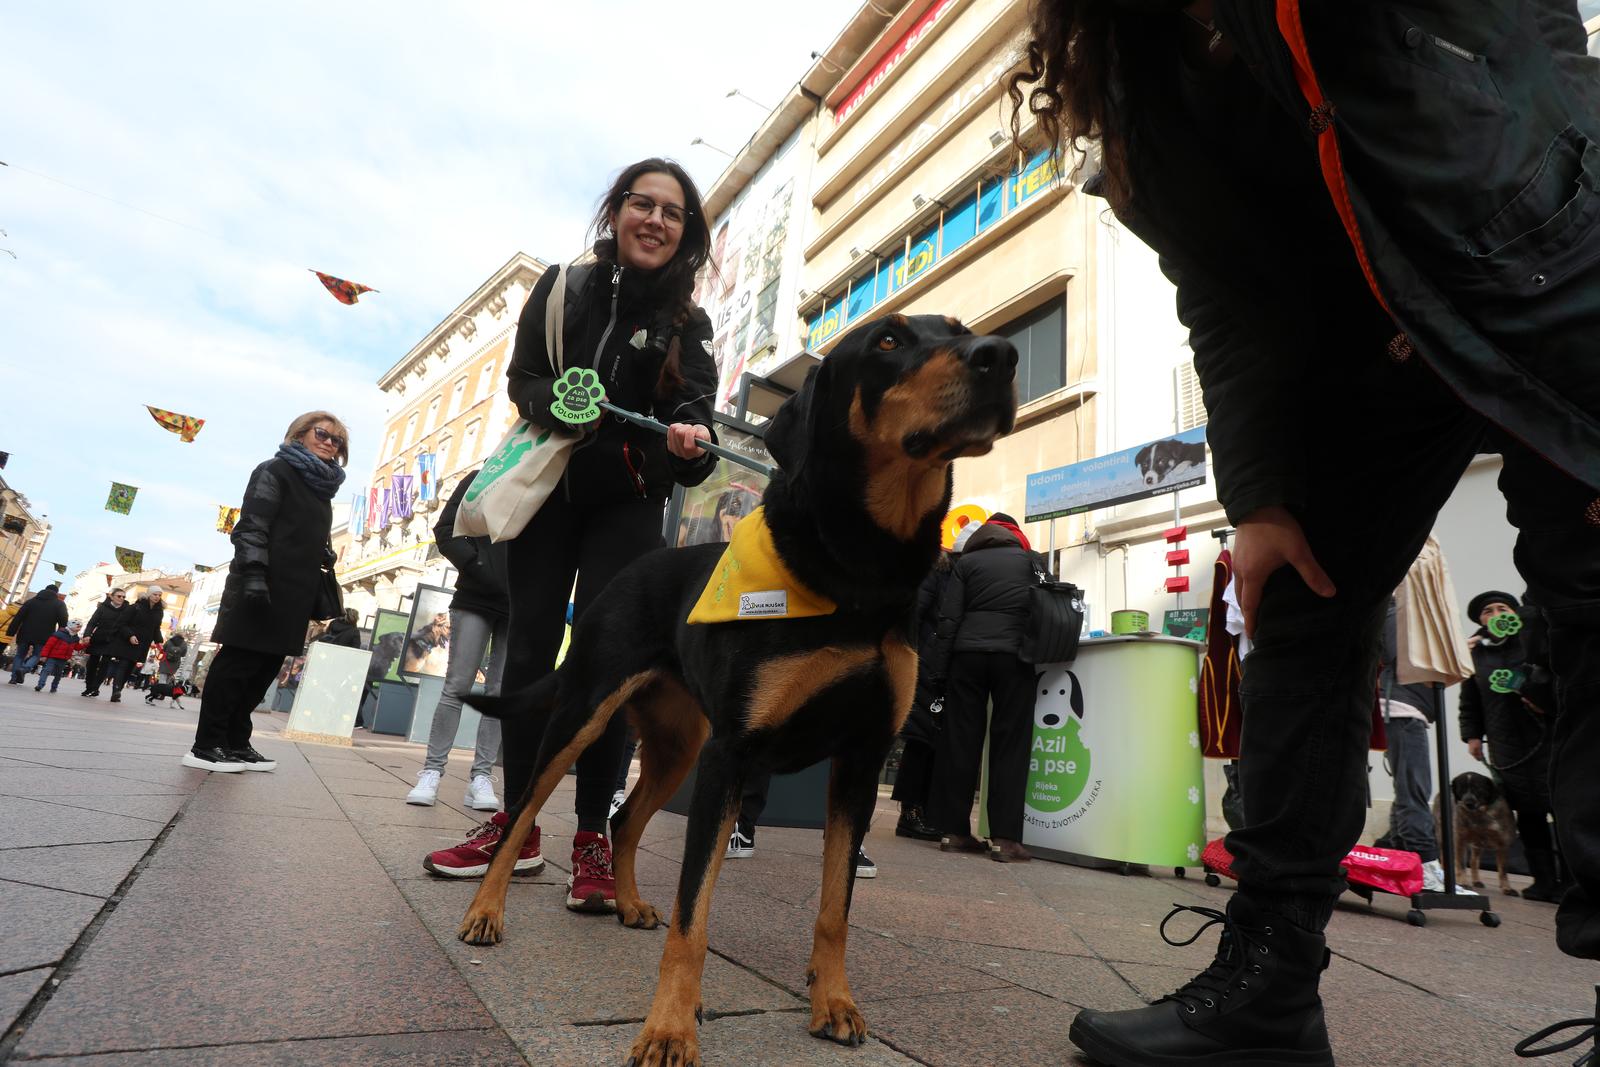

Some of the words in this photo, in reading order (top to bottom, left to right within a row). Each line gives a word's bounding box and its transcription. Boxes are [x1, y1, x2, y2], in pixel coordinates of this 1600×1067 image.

[572, 389, 586, 397] Azil
[555, 403, 597, 420] VOLONTER
[1030, 471, 1065, 487] udomi
[1083, 454, 1129, 473] volontiraj
[1032, 736, 1066, 753] Azil
[1044, 759, 1077, 775] pse
[1035, 782, 1058, 791] Rijeka
[1032, 792, 1061, 802] Viškovo
[1052, 807, 1087, 829] ŽIVOTINJA
[1085, 780, 1102, 808] RIJEKA
